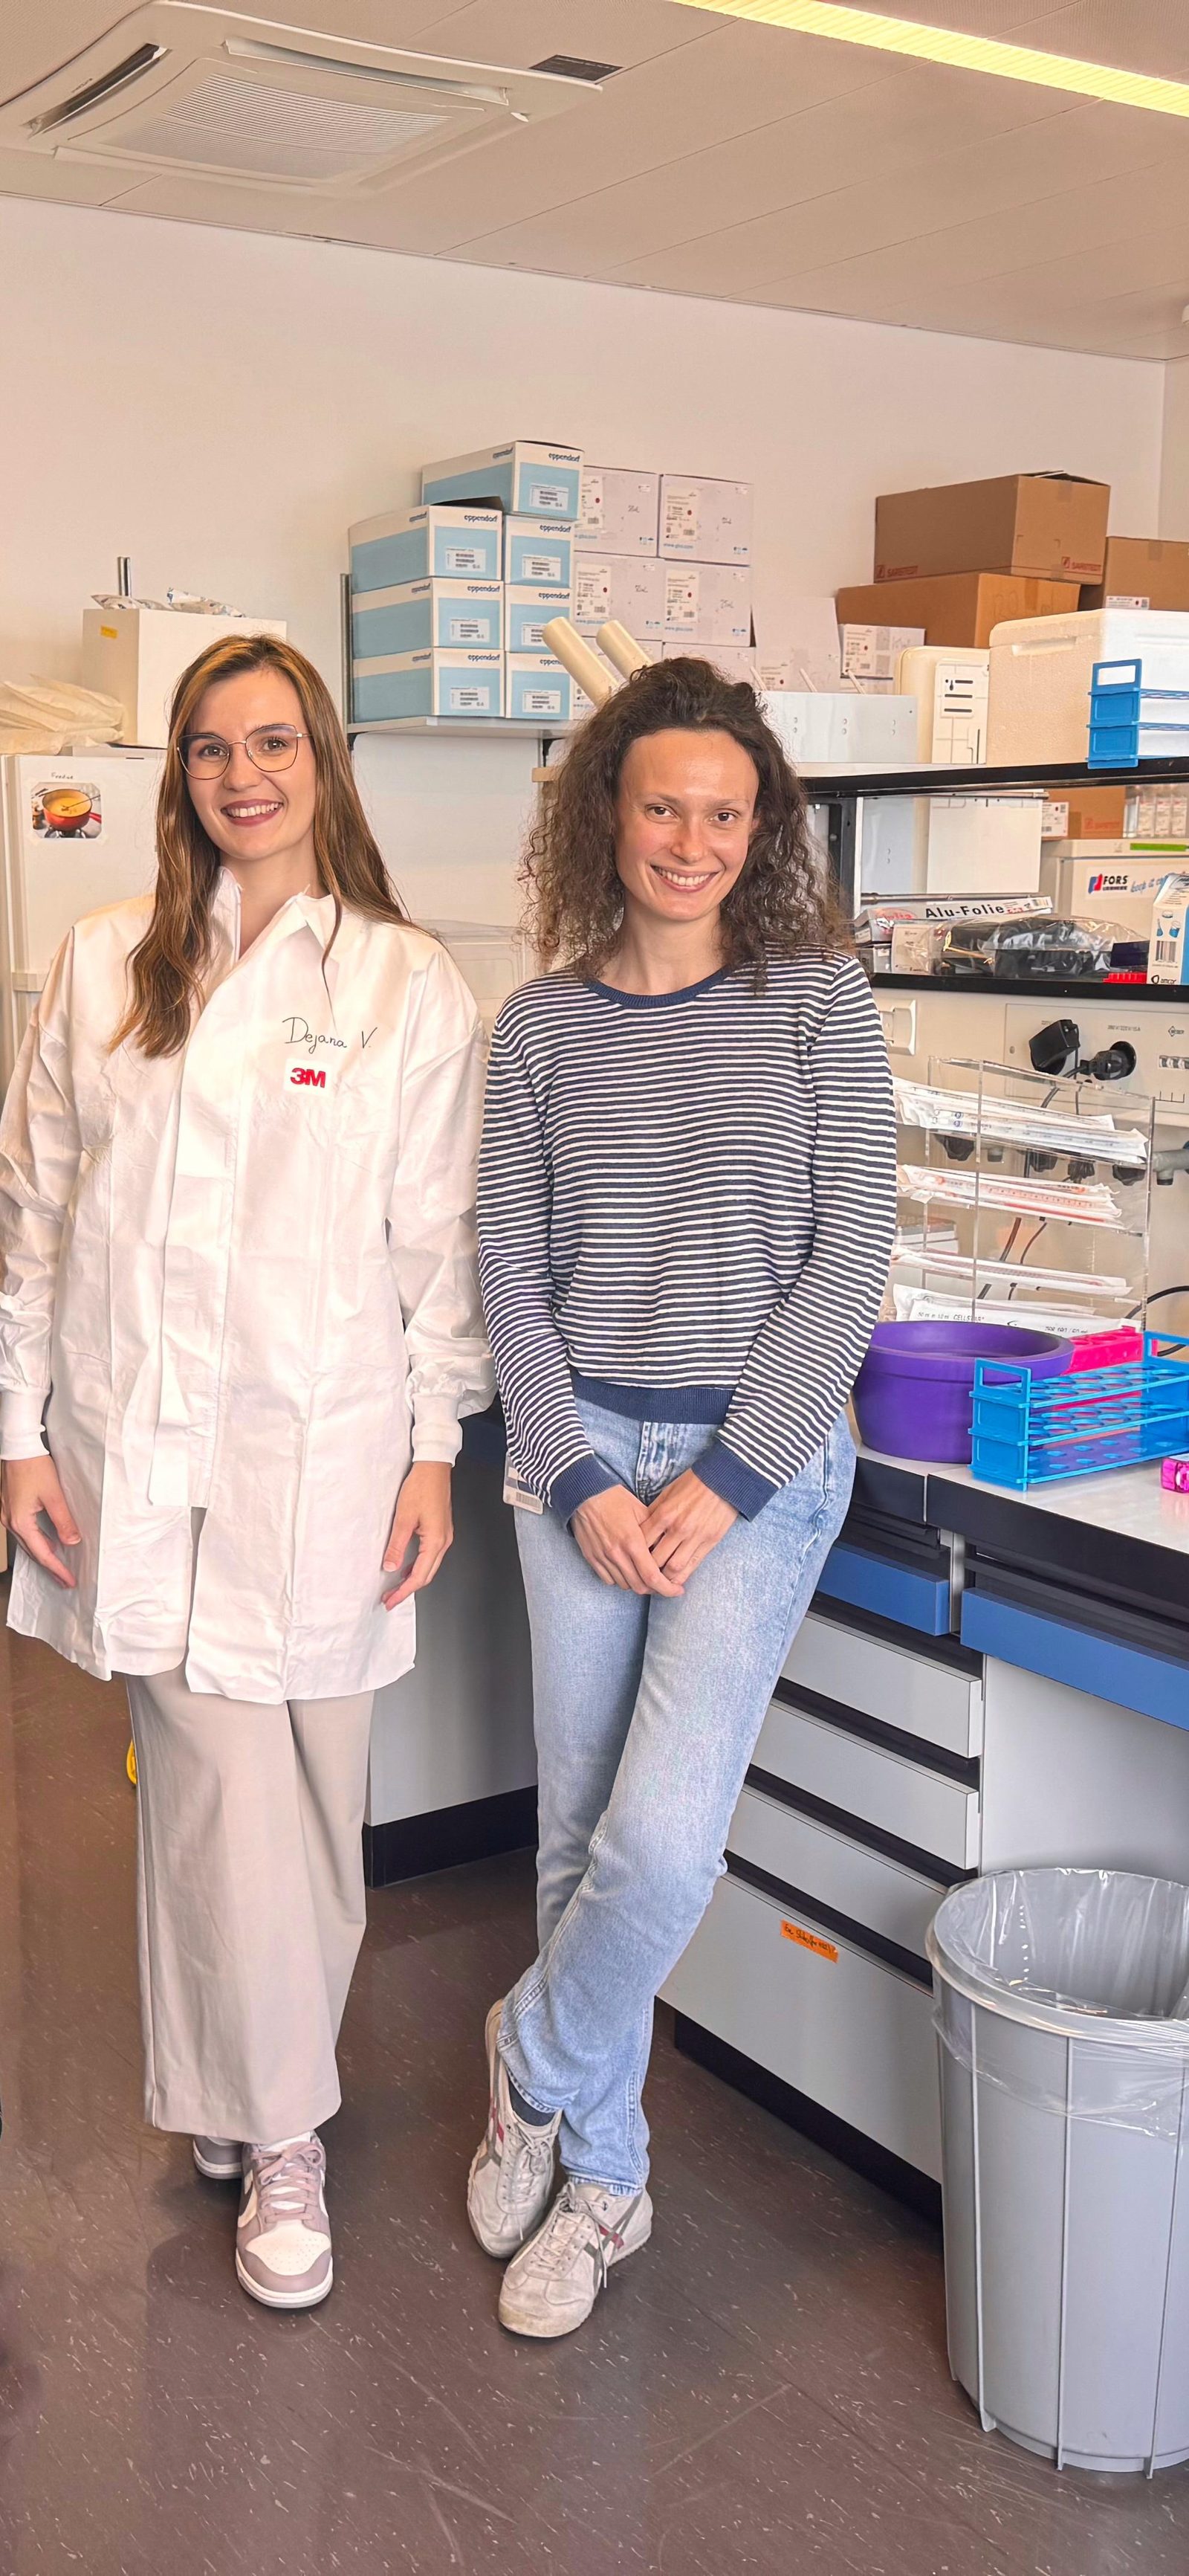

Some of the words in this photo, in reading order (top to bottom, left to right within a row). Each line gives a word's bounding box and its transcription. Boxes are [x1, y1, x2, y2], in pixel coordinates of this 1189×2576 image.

[548, 452, 580, 462] eppendorf
[464, 514, 497, 523] eppendorf
[540, 523, 571, 533] eppendorf
[467, 585, 500, 593] eppendorf
[538, 592, 570, 600] eppendorf
[468, 654, 500, 662] eppendorf
[1103, 876, 1127, 885] FORS
[925, 905, 1004, 919] Alu-Folie
[282, 1016, 348, 1054] Dejana
[290, 1067, 326, 1088] 3M
